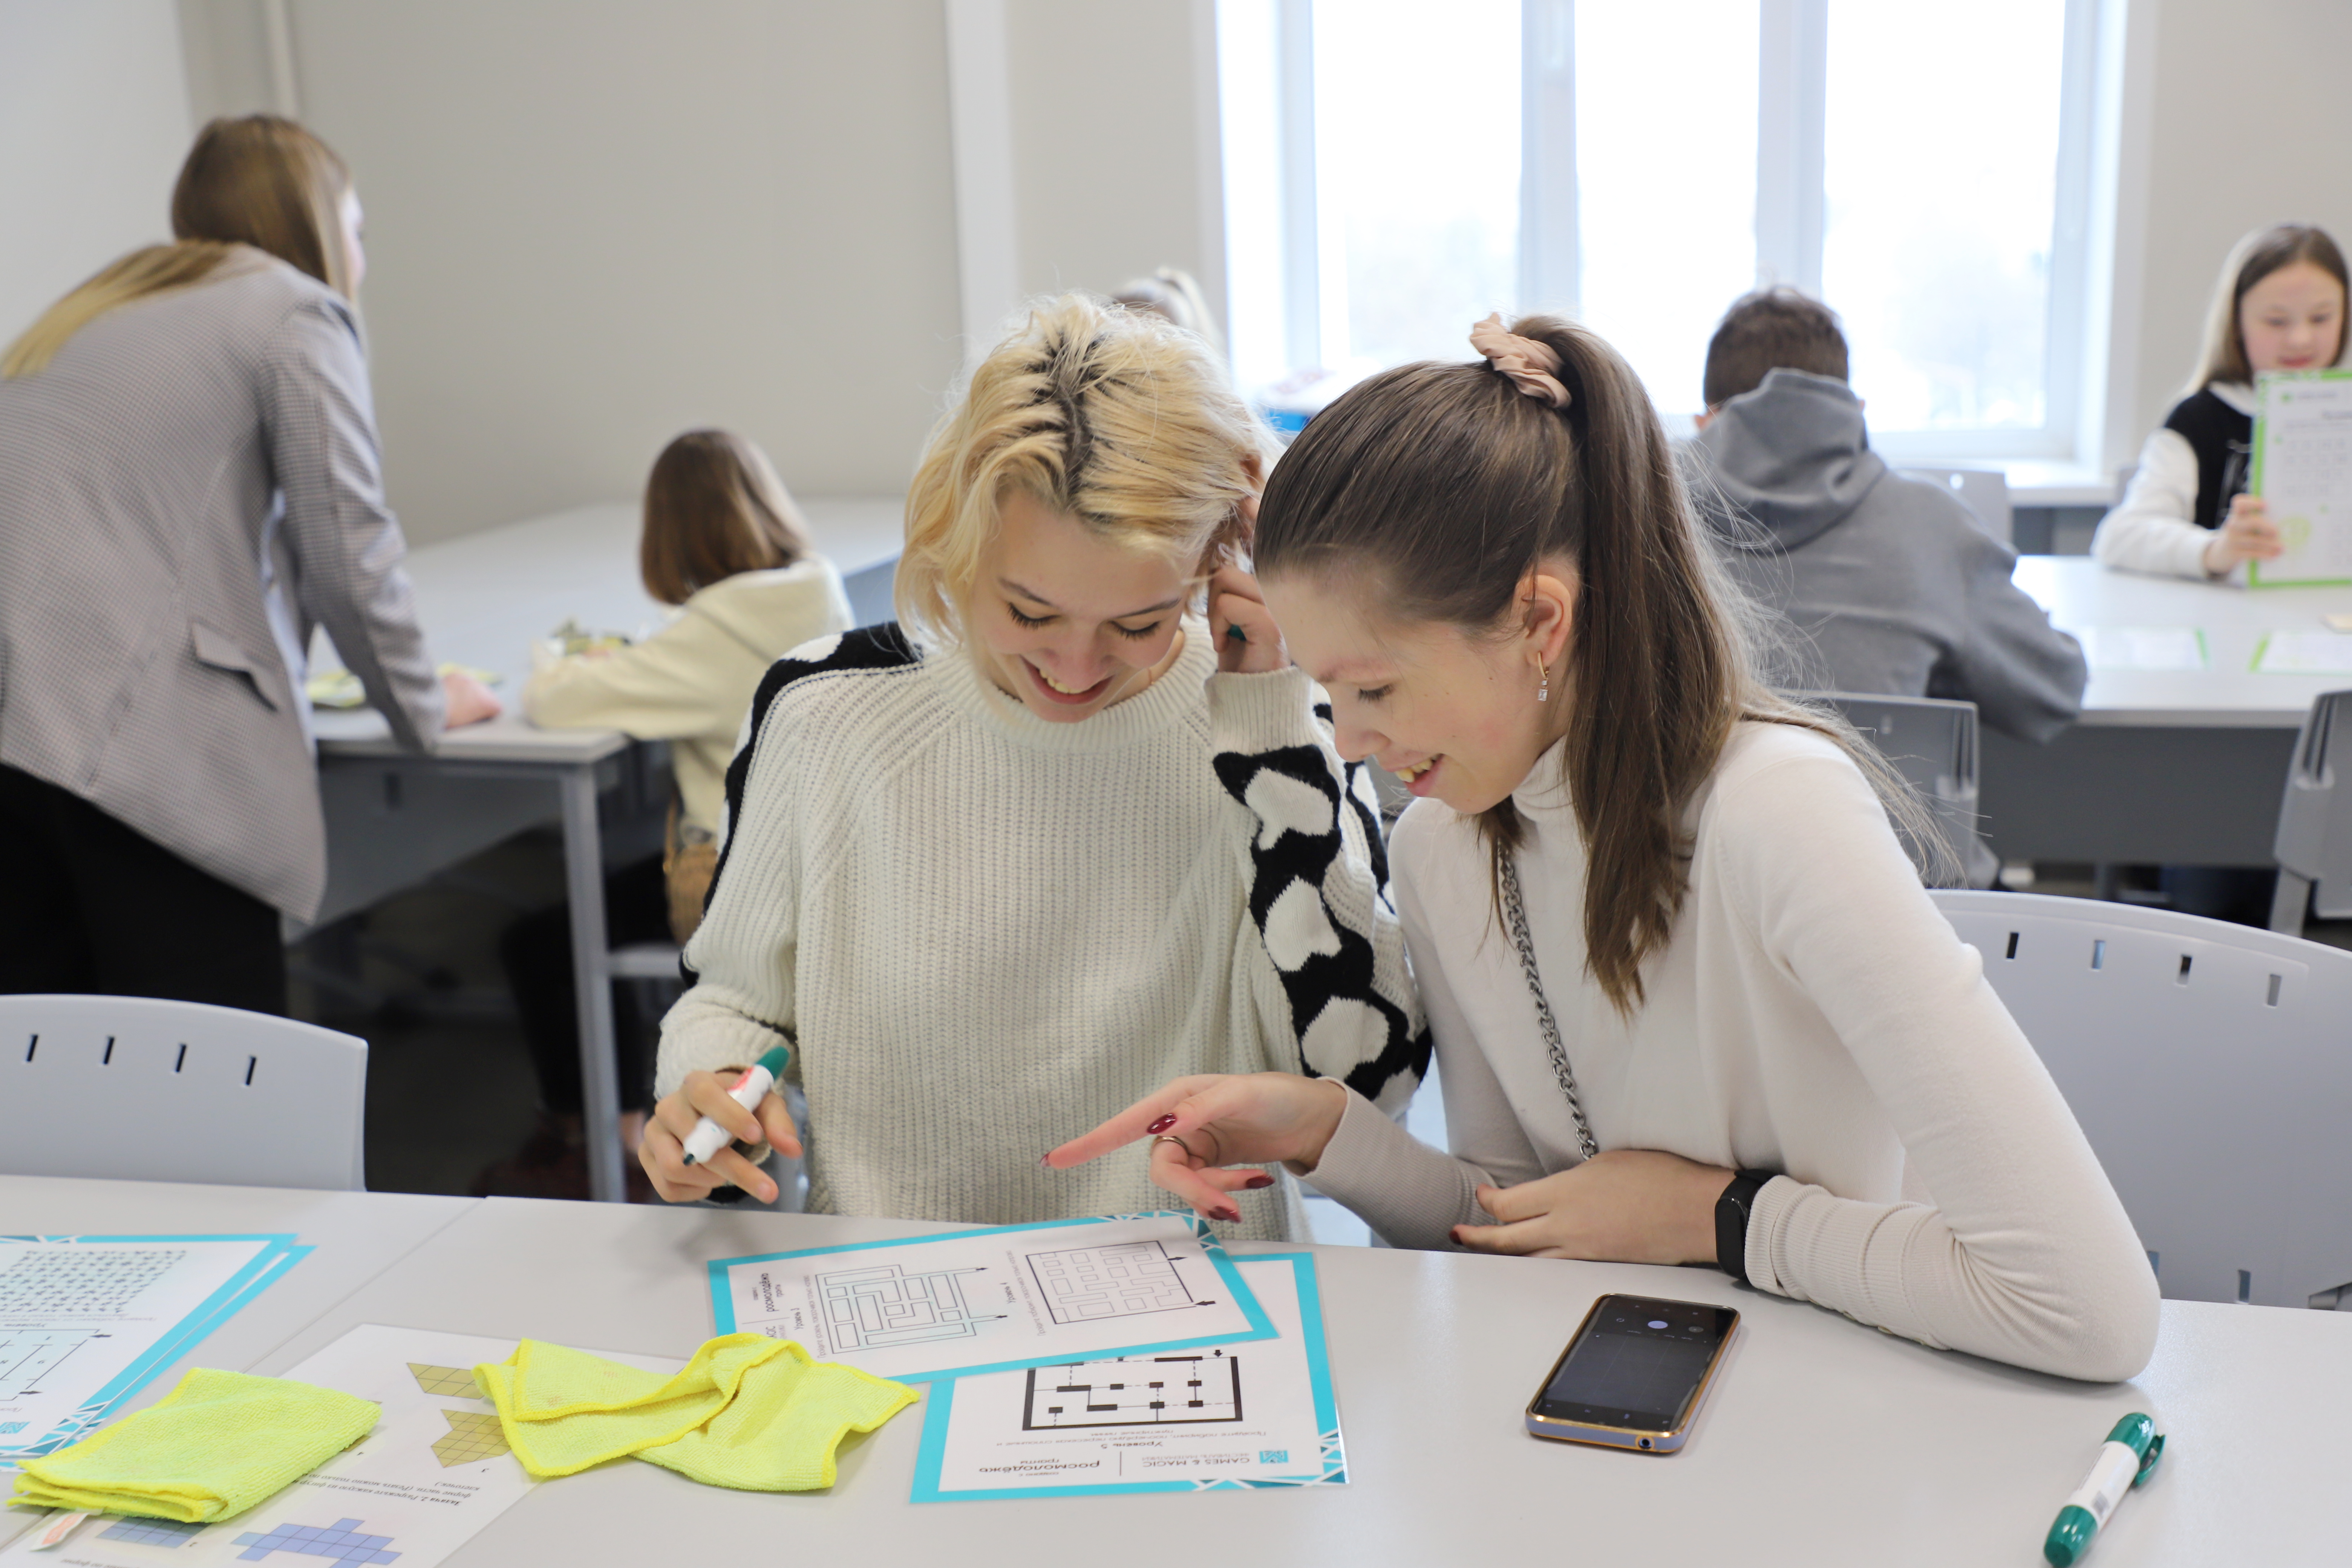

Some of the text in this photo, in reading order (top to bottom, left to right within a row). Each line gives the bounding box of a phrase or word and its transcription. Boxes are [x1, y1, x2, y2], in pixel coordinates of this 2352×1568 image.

[759, 1273, 779, 1312] росмолодёжь
[1004, 1286, 1016, 1303] Уровень
[794, 1312, 804, 1330] Уровень
[766, 1326, 777, 1338] AGIC
[1055, 1435, 1106, 1443] пересекая
[979, 1460, 1099, 1473] росмолодёжь
[299, 1479, 326, 1488] фигур
[435, 1482, 480, 1491] клеточек.)
[374, 1491, 418, 1500] Разрежьте
